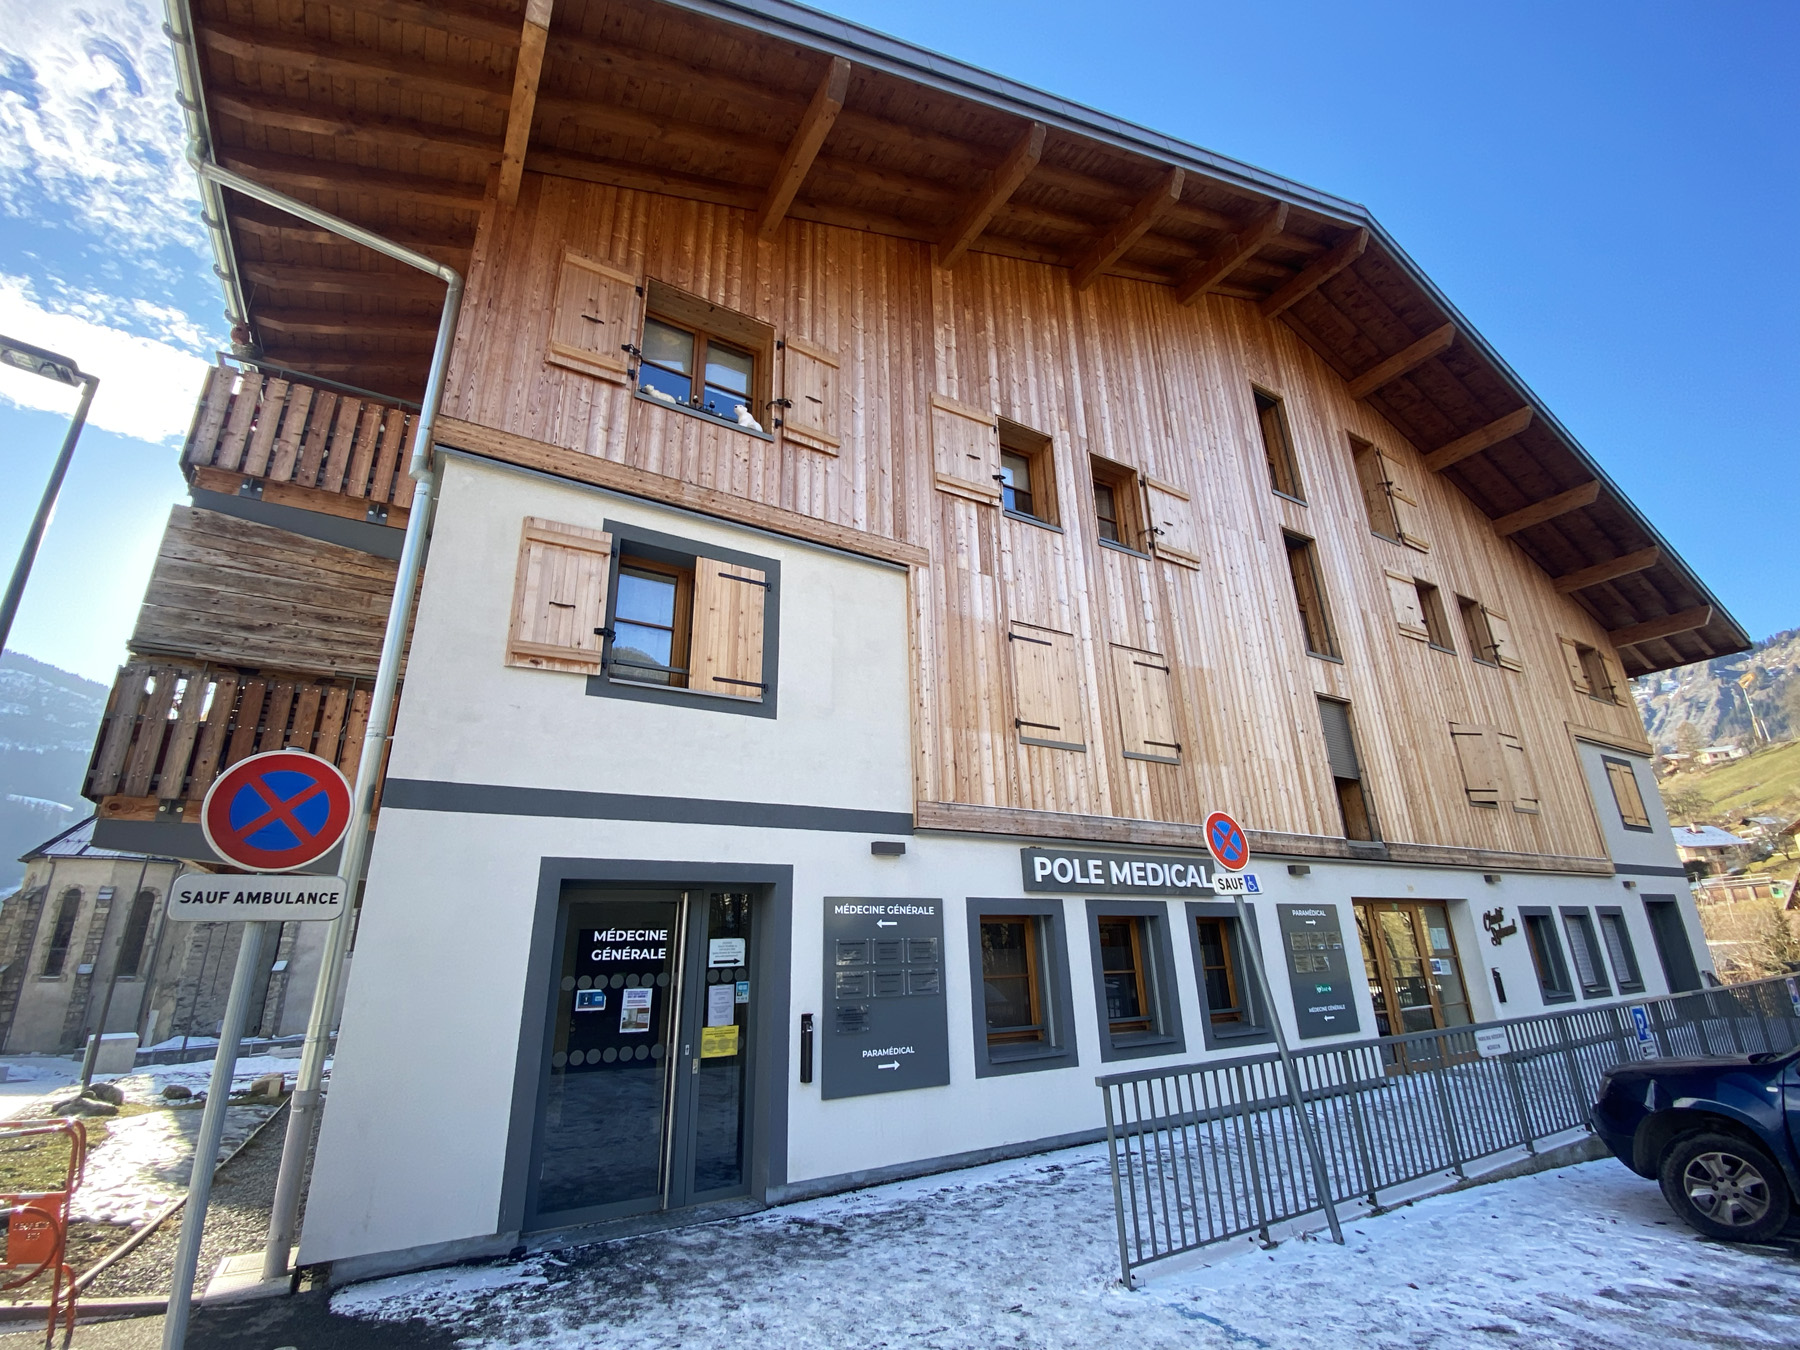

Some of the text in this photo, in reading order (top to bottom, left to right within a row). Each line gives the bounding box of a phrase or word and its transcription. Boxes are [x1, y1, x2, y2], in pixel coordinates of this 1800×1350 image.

[1033, 856, 1214, 889] POLE MEDICAL
[1217, 877, 1244, 891] SAUF
[179, 890, 339, 905] SAUF AMBULANCE
[834, 903, 935, 915] MÉDECINE GÉNÉRALE
[593, 928, 668, 942] MÉDECINE
[591, 946, 666, 961] GÉNÉRALE
[862, 1046, 915, 1059] PARAMÉDICAL
